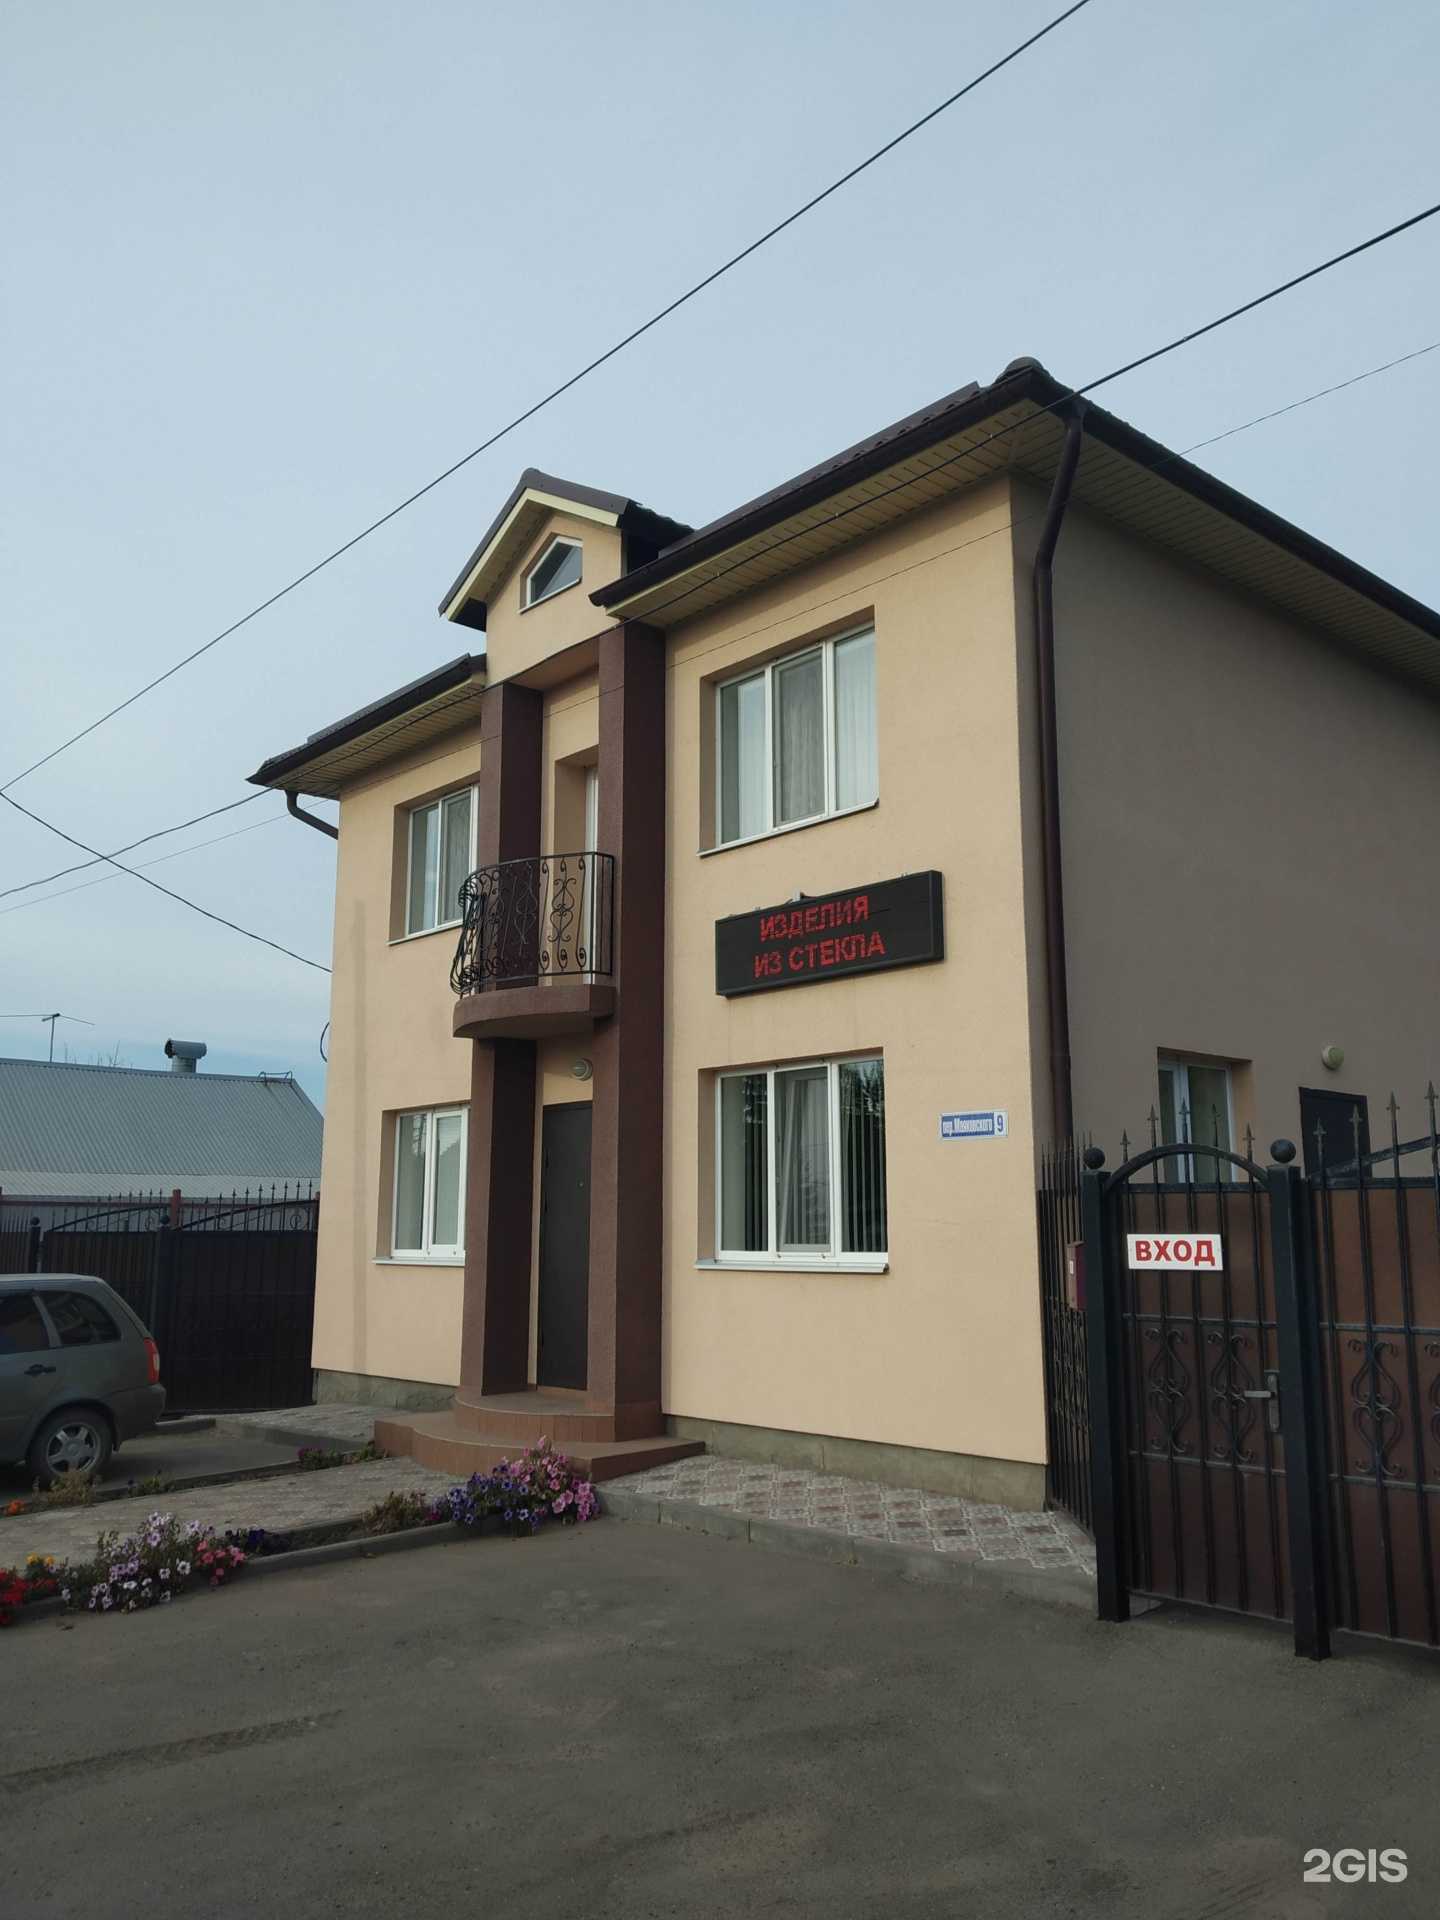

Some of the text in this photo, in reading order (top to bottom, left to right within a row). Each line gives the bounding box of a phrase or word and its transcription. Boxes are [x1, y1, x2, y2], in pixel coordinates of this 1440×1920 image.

[760, 895, 869, 942] ИЗДЕЛИЯ
[754, 931, 886, 978] ИЗ СТЕКЛА
[997, 1114, 1004, 1132] 9
[1135, 1240, 1216, 1266] ВХОД
